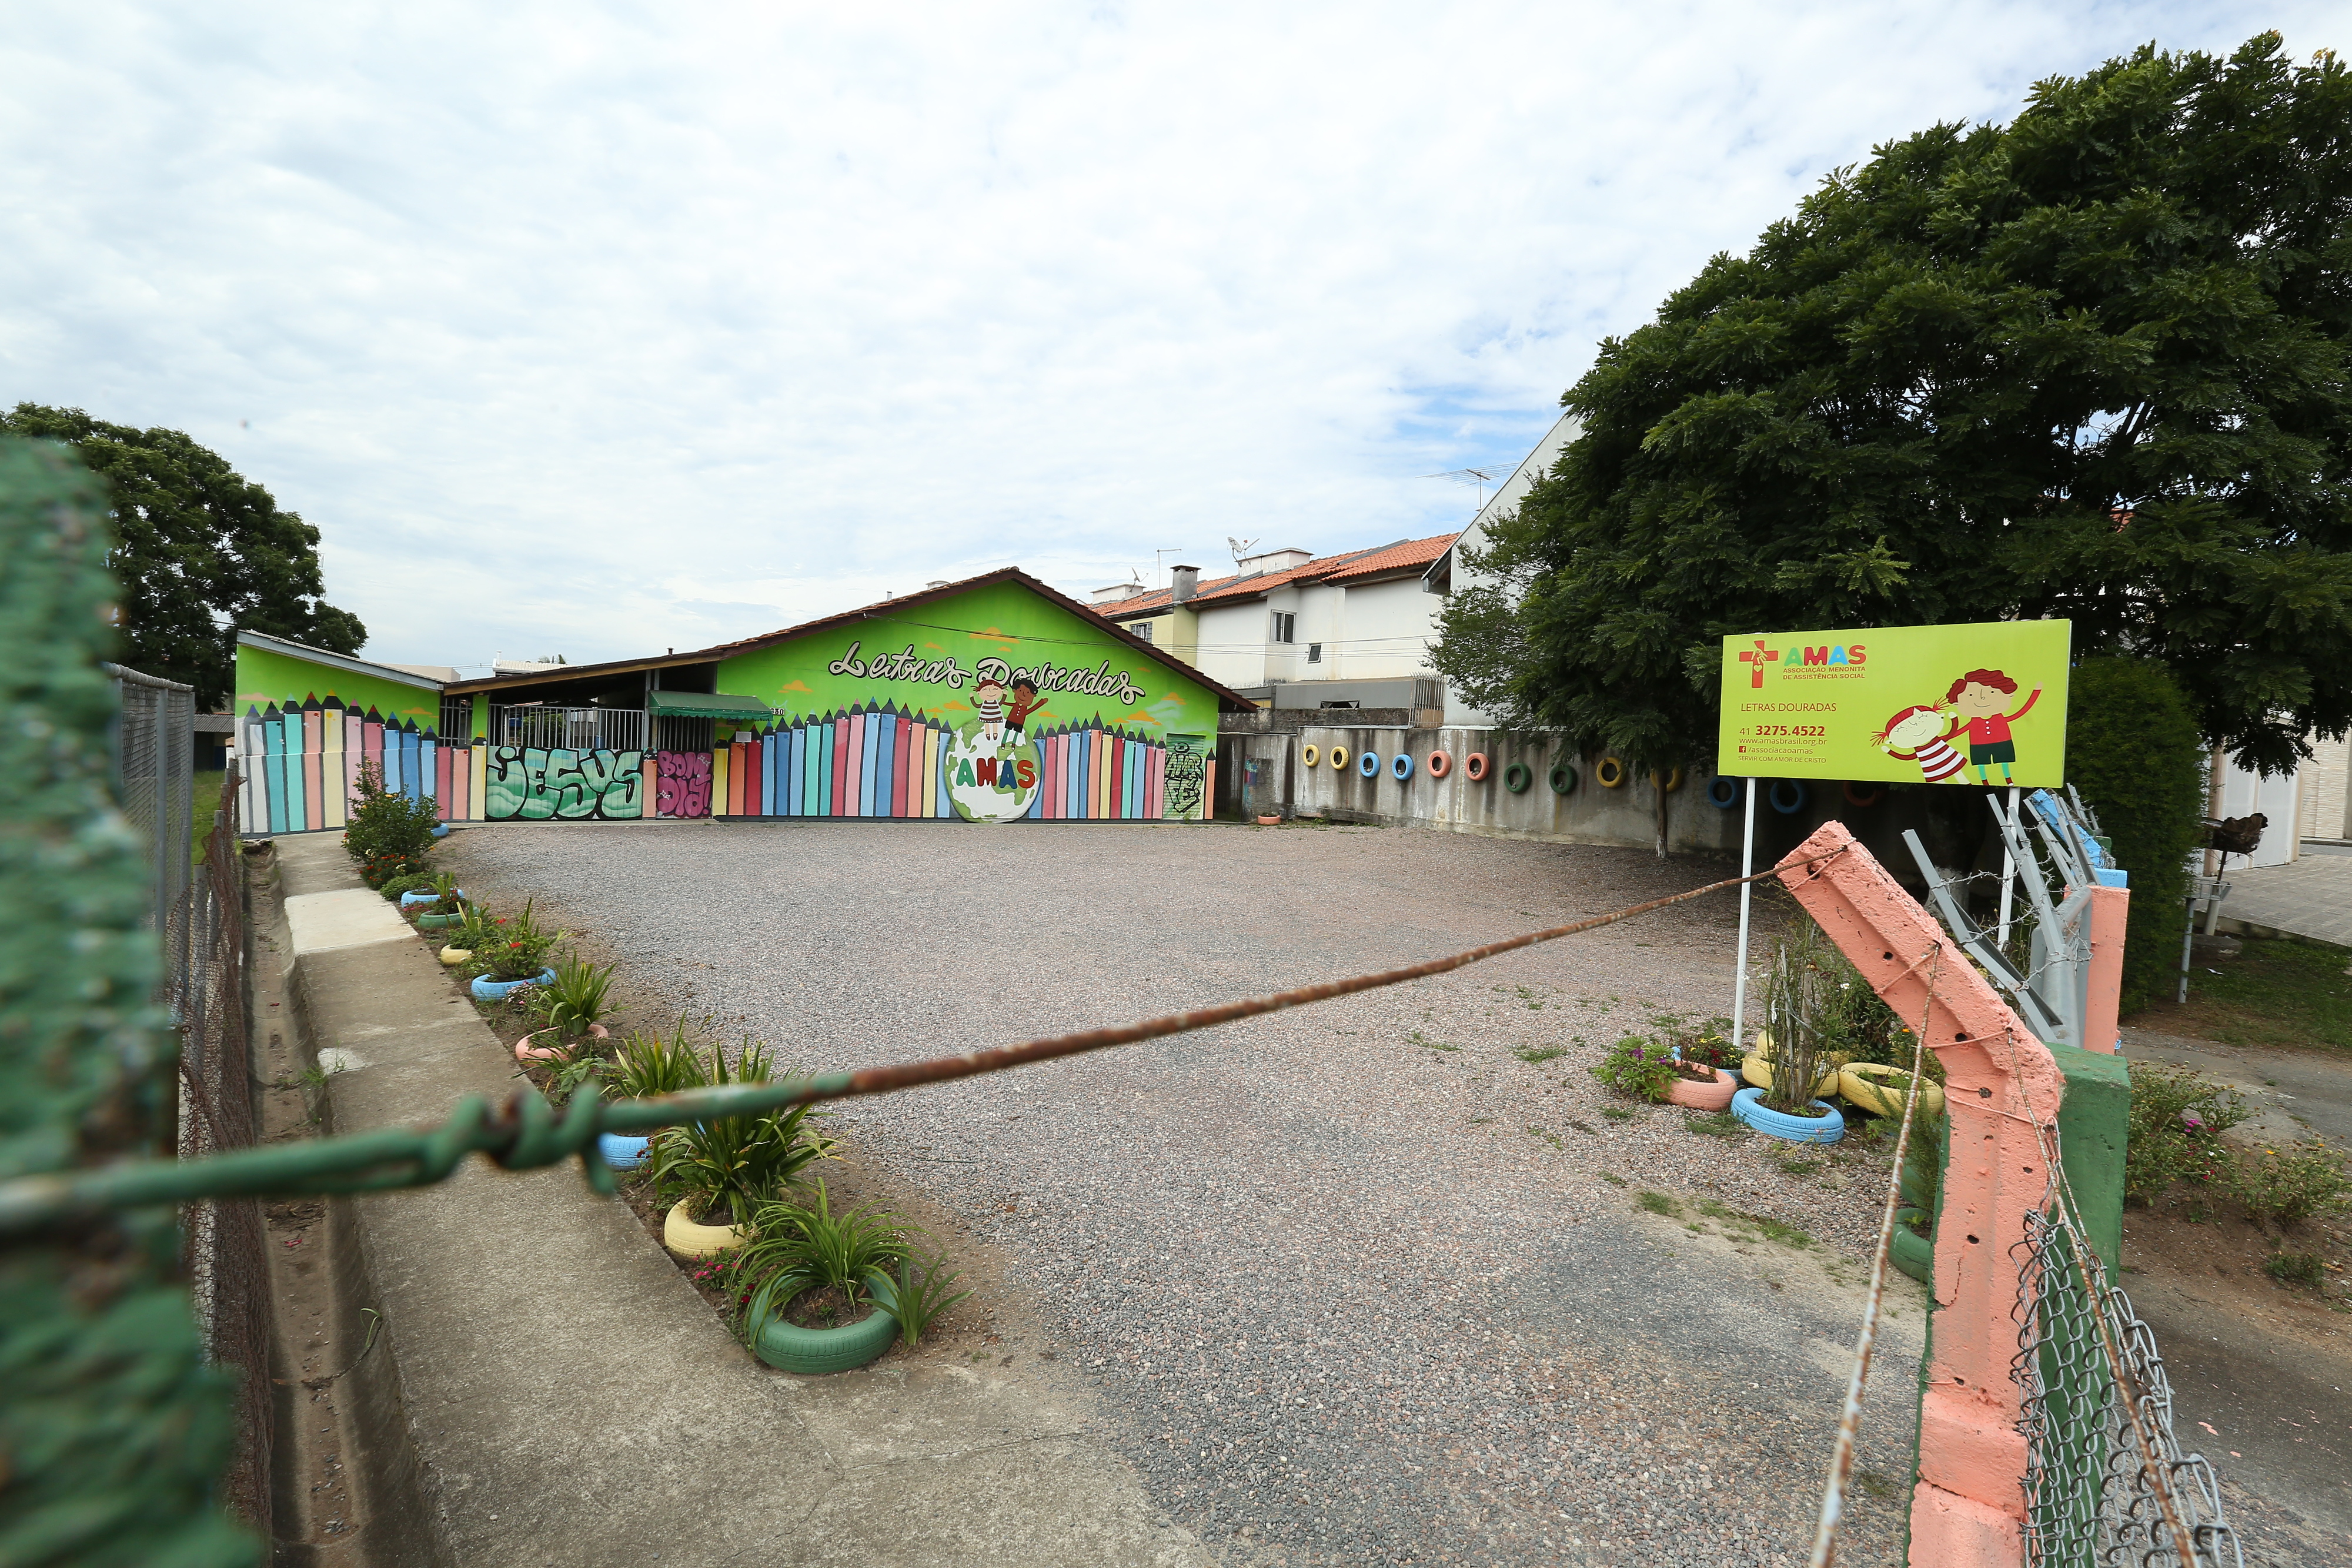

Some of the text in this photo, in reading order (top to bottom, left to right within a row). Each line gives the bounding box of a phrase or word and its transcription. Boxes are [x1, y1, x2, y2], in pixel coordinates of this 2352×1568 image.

[1784, 645, 1866, 666] AMAS
[828, 641, 1145, 705] Letras Douradas
[1741, 703, 1836, 711] LETRAS DOURADAS
[1756, 726, 1825, 736] 3275.4522
[1739, 738, 1827, 746] www.amasbrasil.org.br
[956, 757, 1035, 789] AMAS
